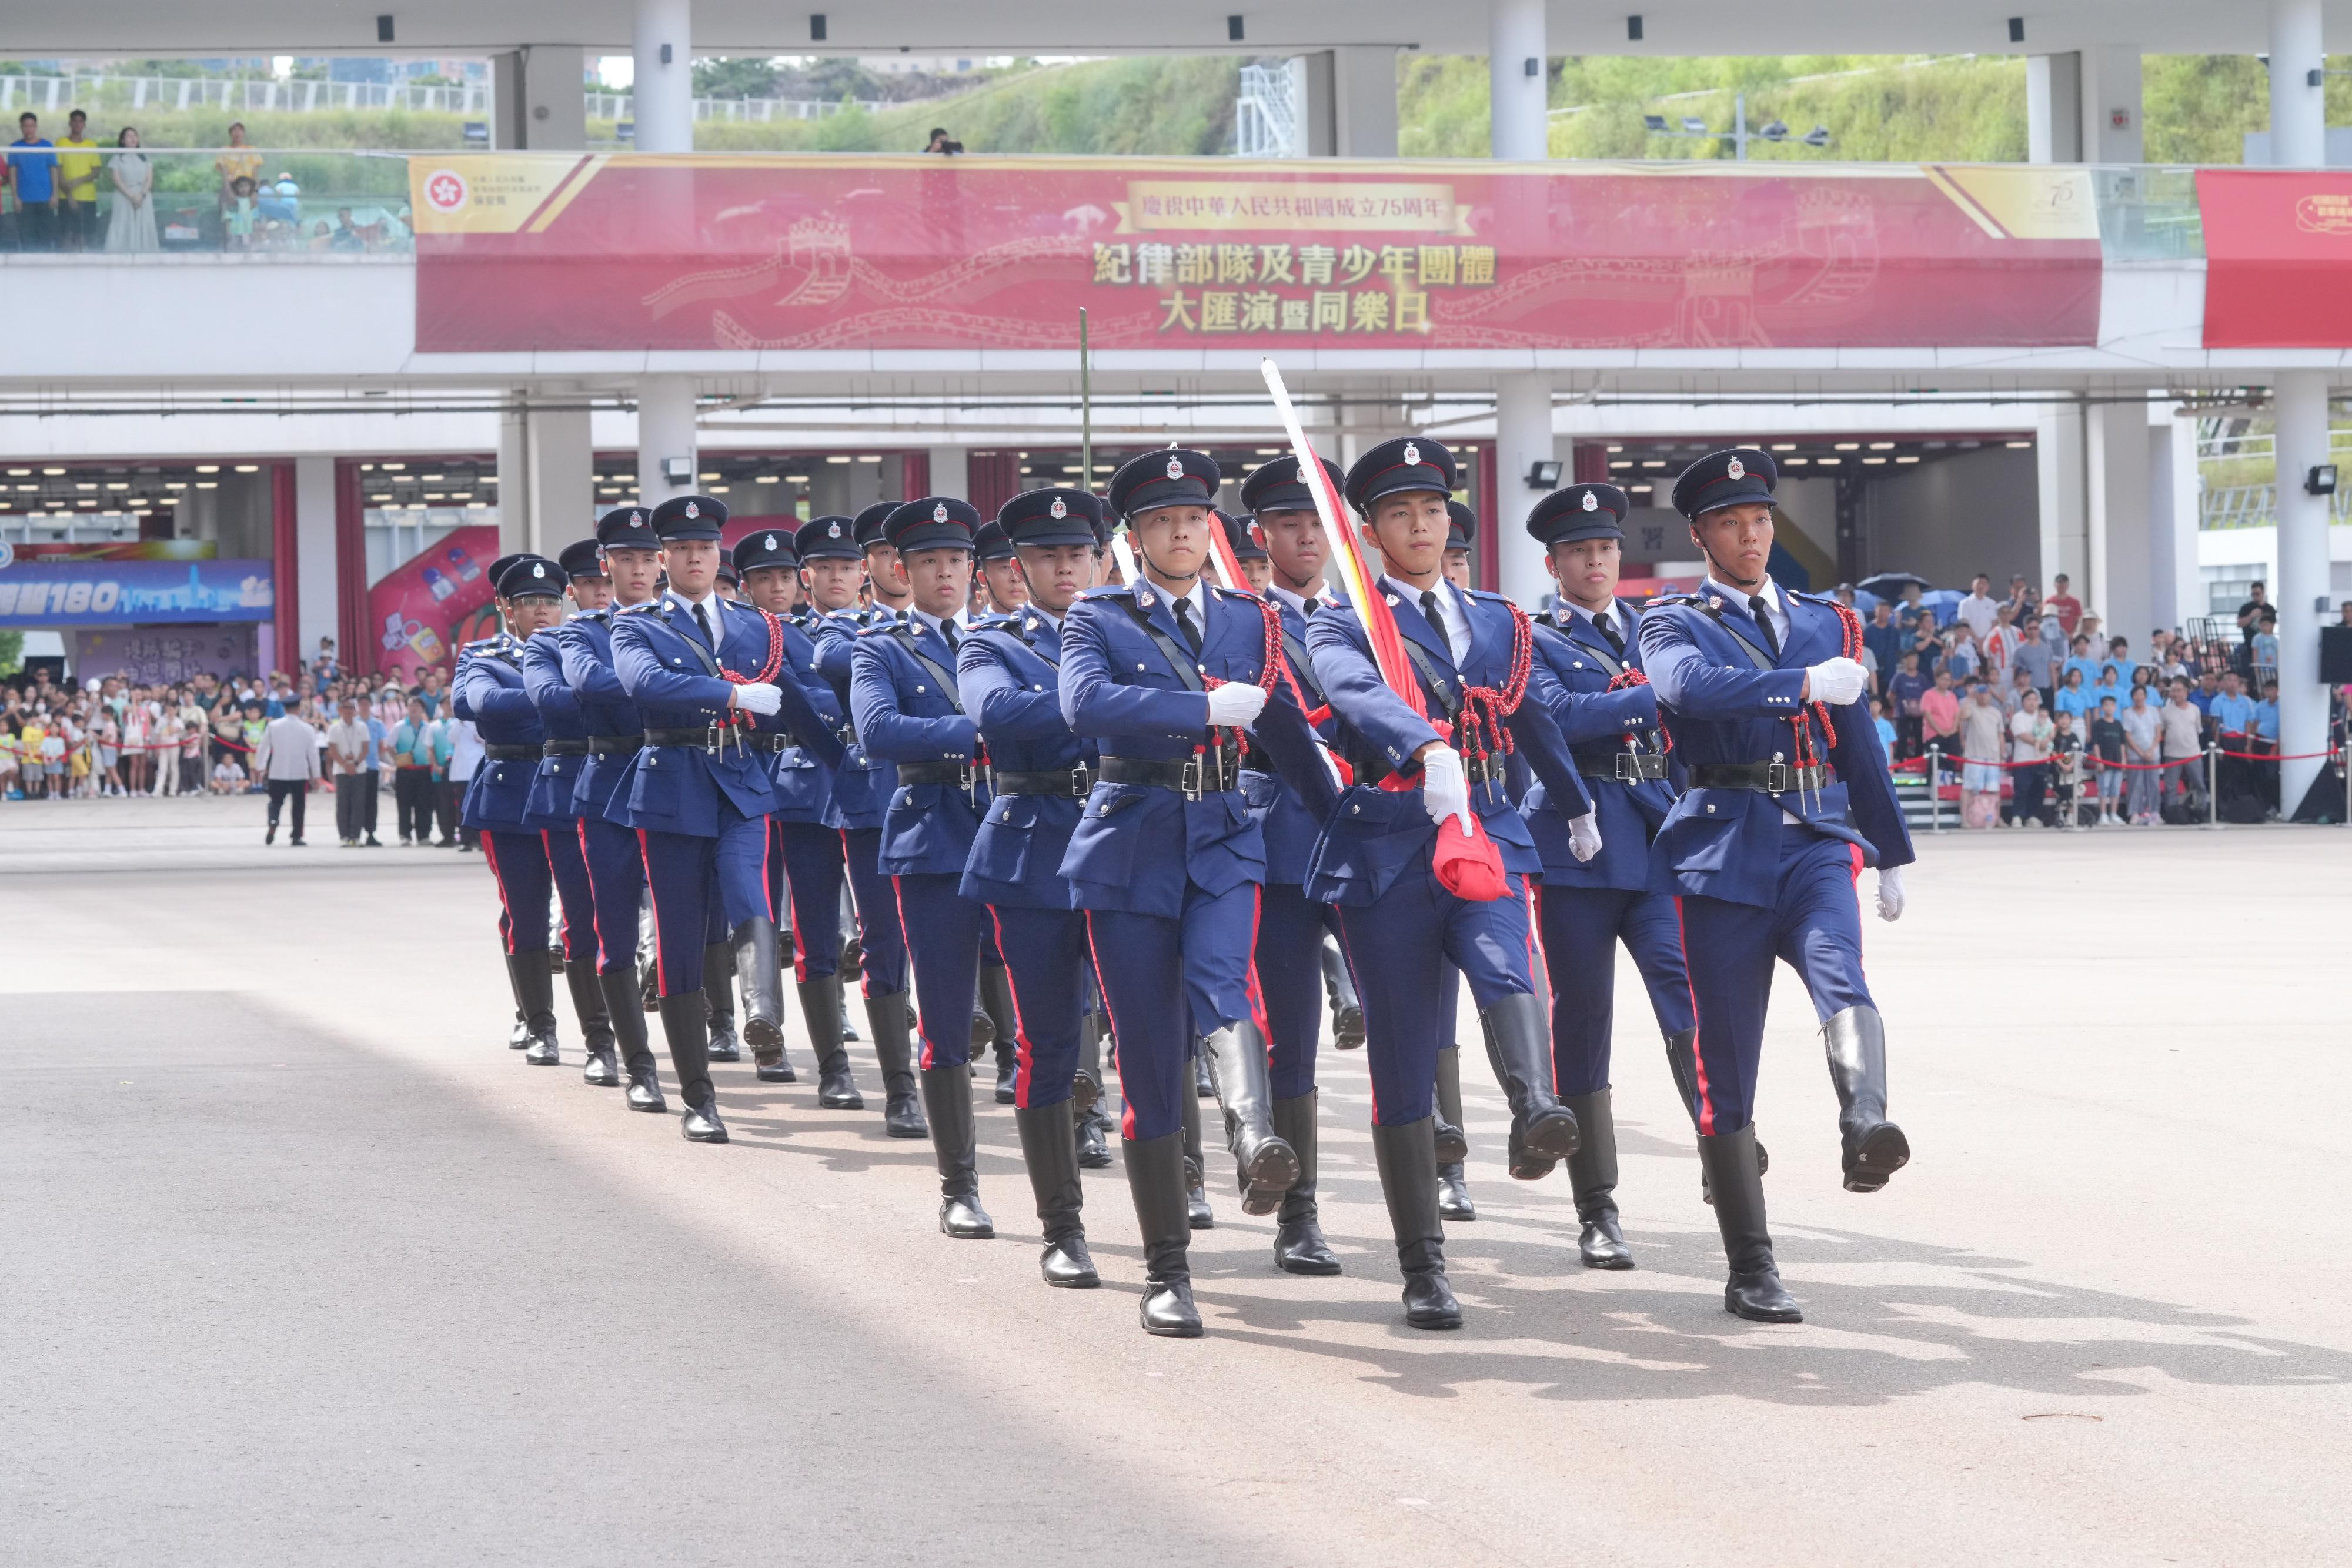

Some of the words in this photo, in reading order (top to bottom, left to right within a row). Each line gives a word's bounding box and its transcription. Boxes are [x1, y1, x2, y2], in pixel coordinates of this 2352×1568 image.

[1142, 195, 1442, 218] 慶祝中華人民共和國成立75周年
[1093, 242, 1496, 285] 紀律部隊及青少年團體
[1158, 290, 1429, 333] 大匯演暨同樂日
